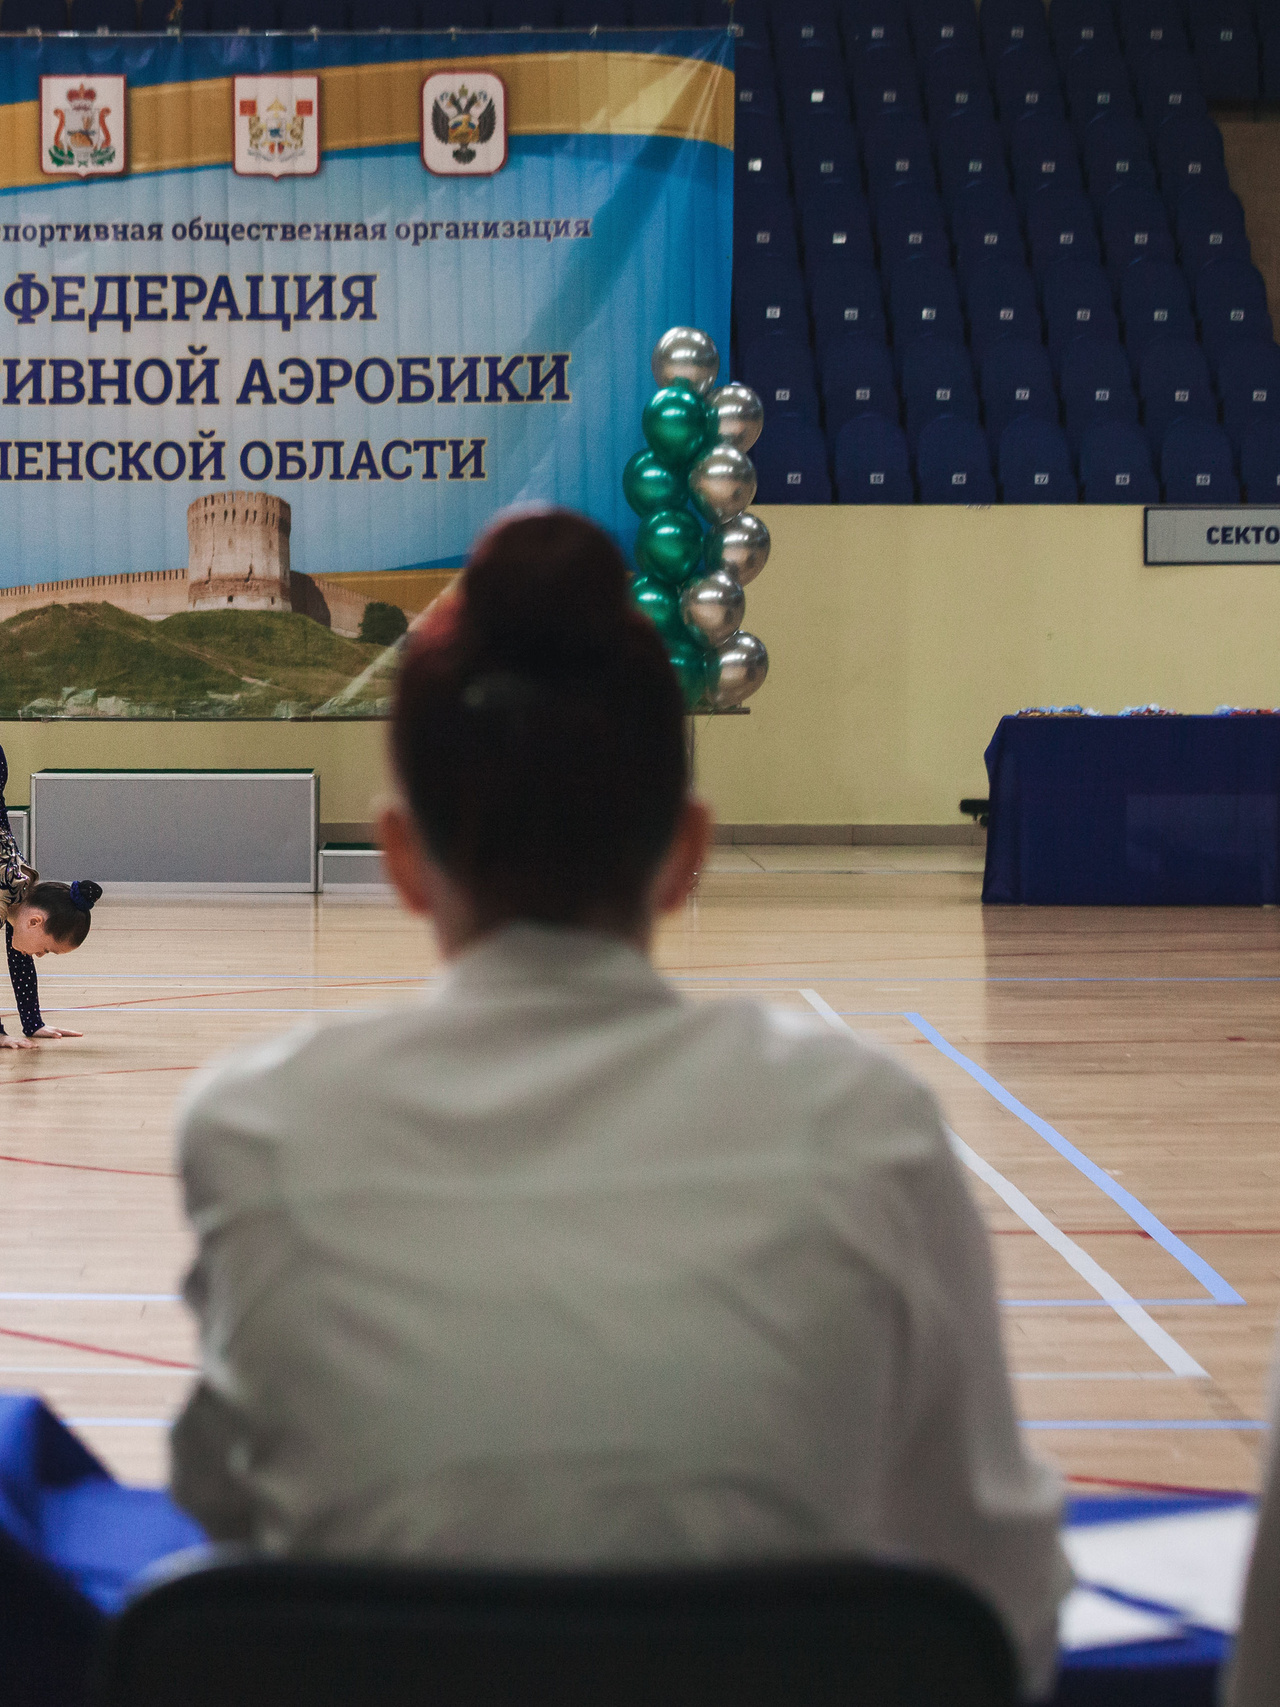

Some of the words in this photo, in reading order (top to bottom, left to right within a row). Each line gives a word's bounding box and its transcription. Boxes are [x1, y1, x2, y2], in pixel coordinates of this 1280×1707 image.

[172, 217, 387, 243] общественная
[395, 219, 592, 246] организация
[4, 273, 377, 332] ФЕДЕРАЦИЯ
[236, 352, 571, 405] АЭРОБИКИ
[240, 438, 487, 482] ОБЛАСТИ
